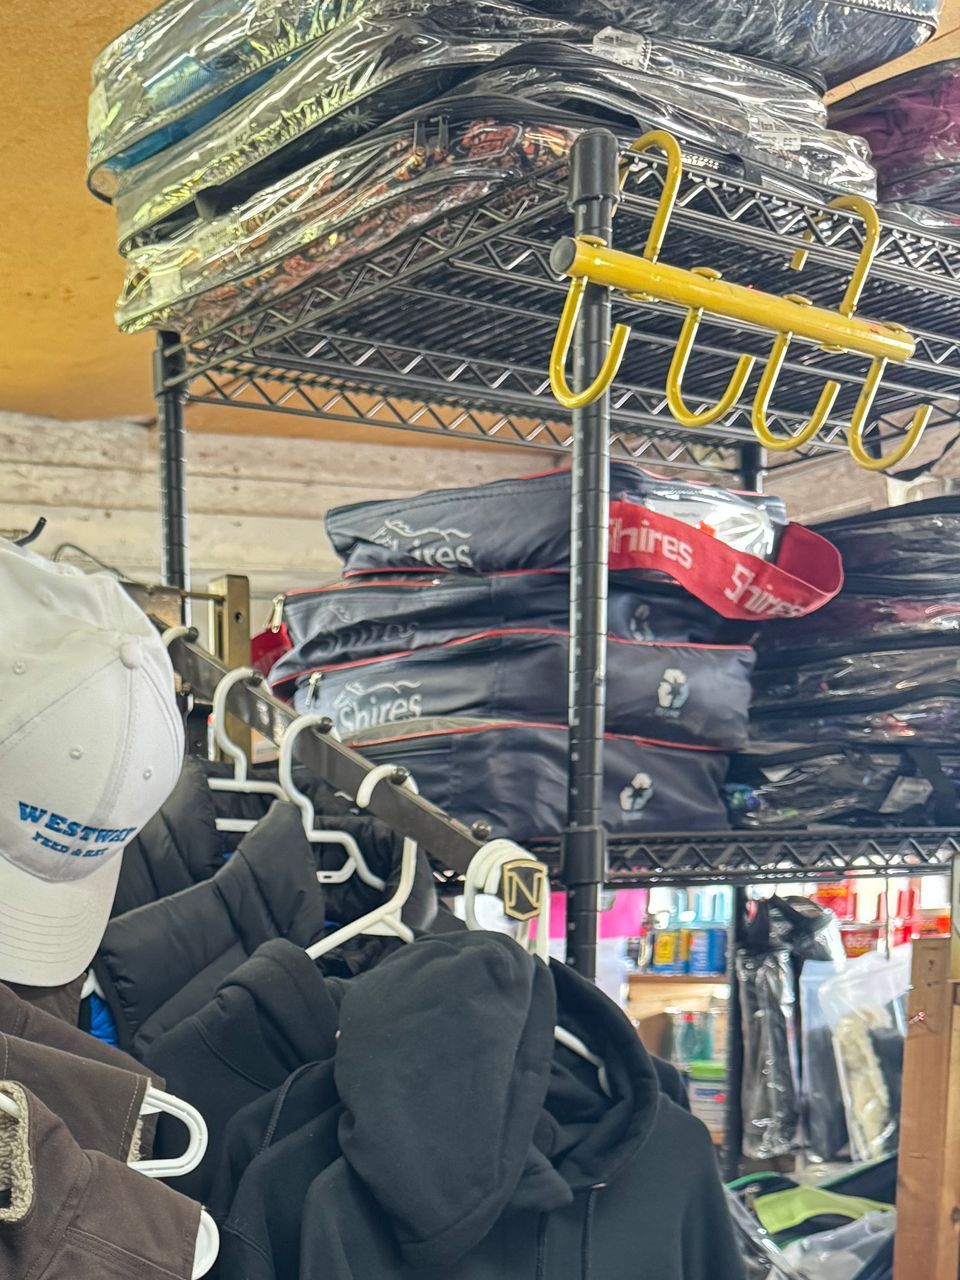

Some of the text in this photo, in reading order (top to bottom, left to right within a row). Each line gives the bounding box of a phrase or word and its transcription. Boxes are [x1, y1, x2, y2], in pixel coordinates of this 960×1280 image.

[724, 562, 808, 619] Shires
[340, 693, 423, 731] Shires
[18, 800, 137, 842] WESTWAY
